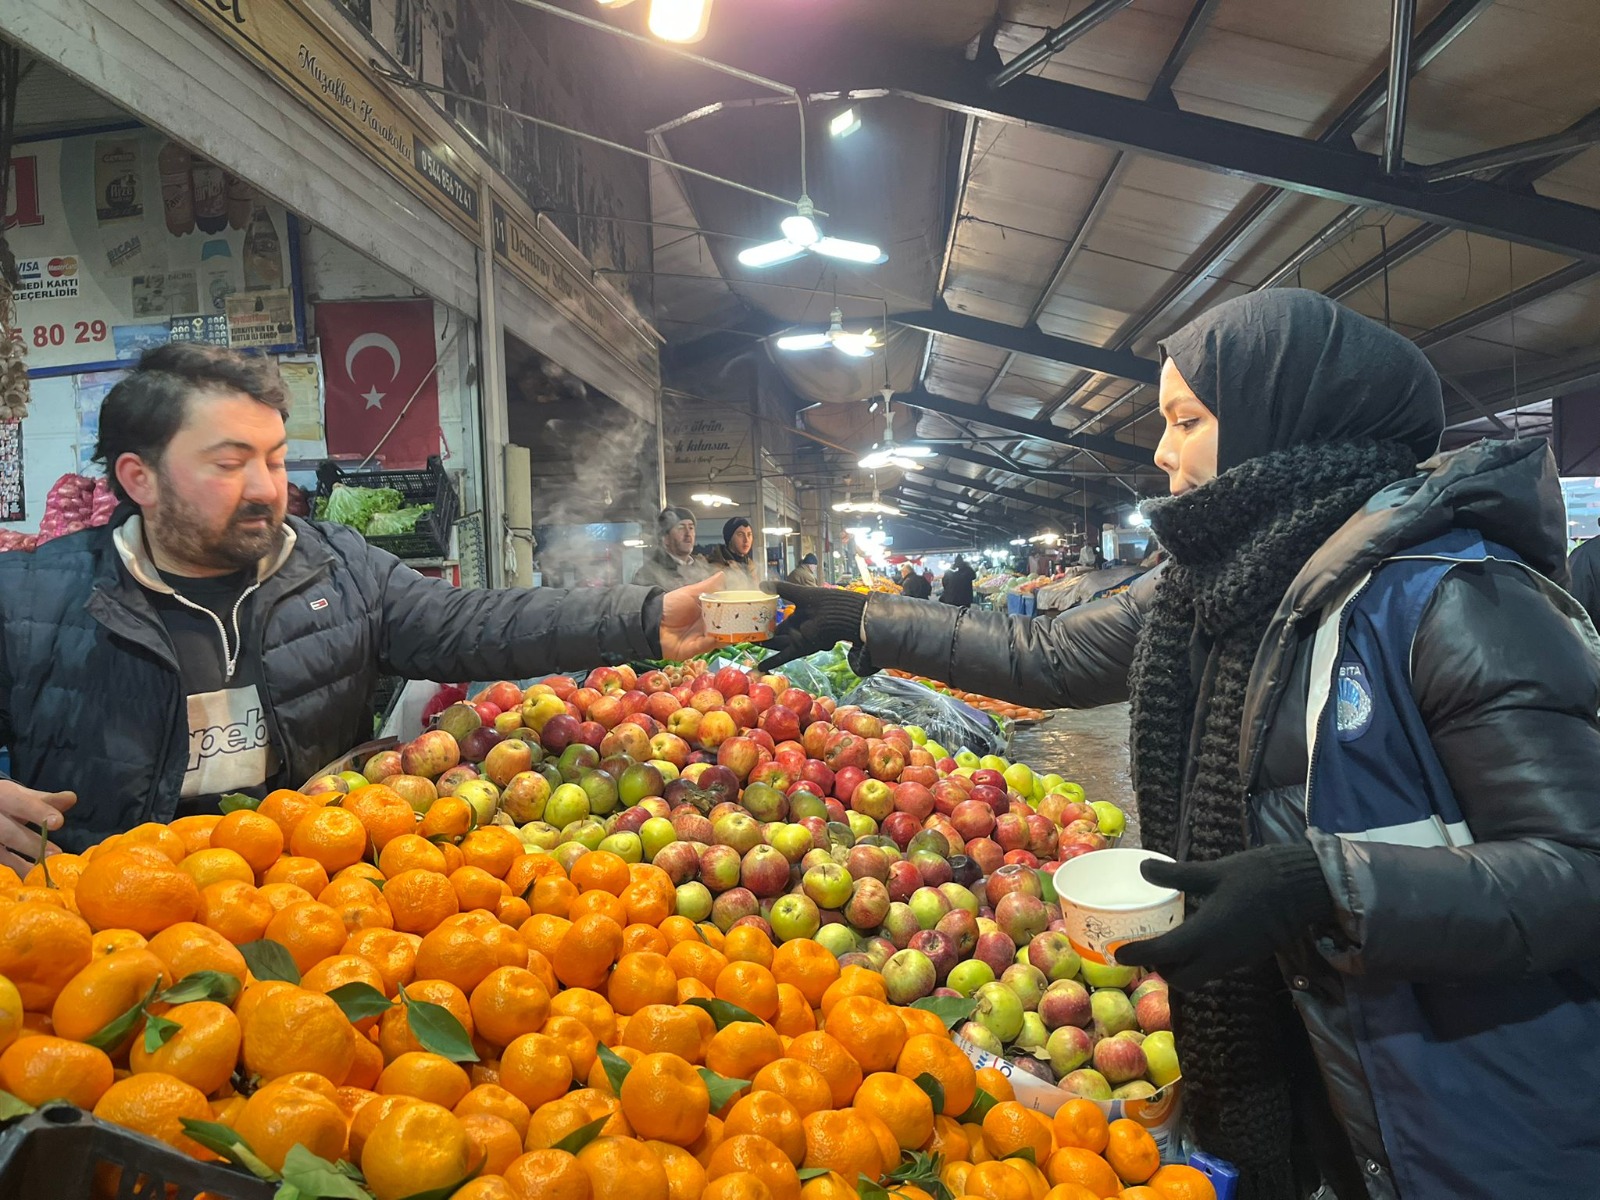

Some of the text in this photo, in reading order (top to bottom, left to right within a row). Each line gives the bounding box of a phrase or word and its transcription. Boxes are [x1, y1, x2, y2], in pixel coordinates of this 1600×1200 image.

[298, 44, 357, 113] Muzaffer
[421, 150, 427, 171] 0
[427, 154, 441, 185] 544
[454, 180, 463, 204] 72
[463, 190, 472, 211] 41
[495, 217, 505, 243] 11
[509, 223, 551, 282] Demiray
[15, 261, 40, 272] VISA
[13, 288, 78, 301] GEÇERLİDİR
[46, 278, 78, 288] KARTI
[33, 323, 65, 348] 80
[74, 319, 107, 344] 29
[266, 324, 275, 333] EN
